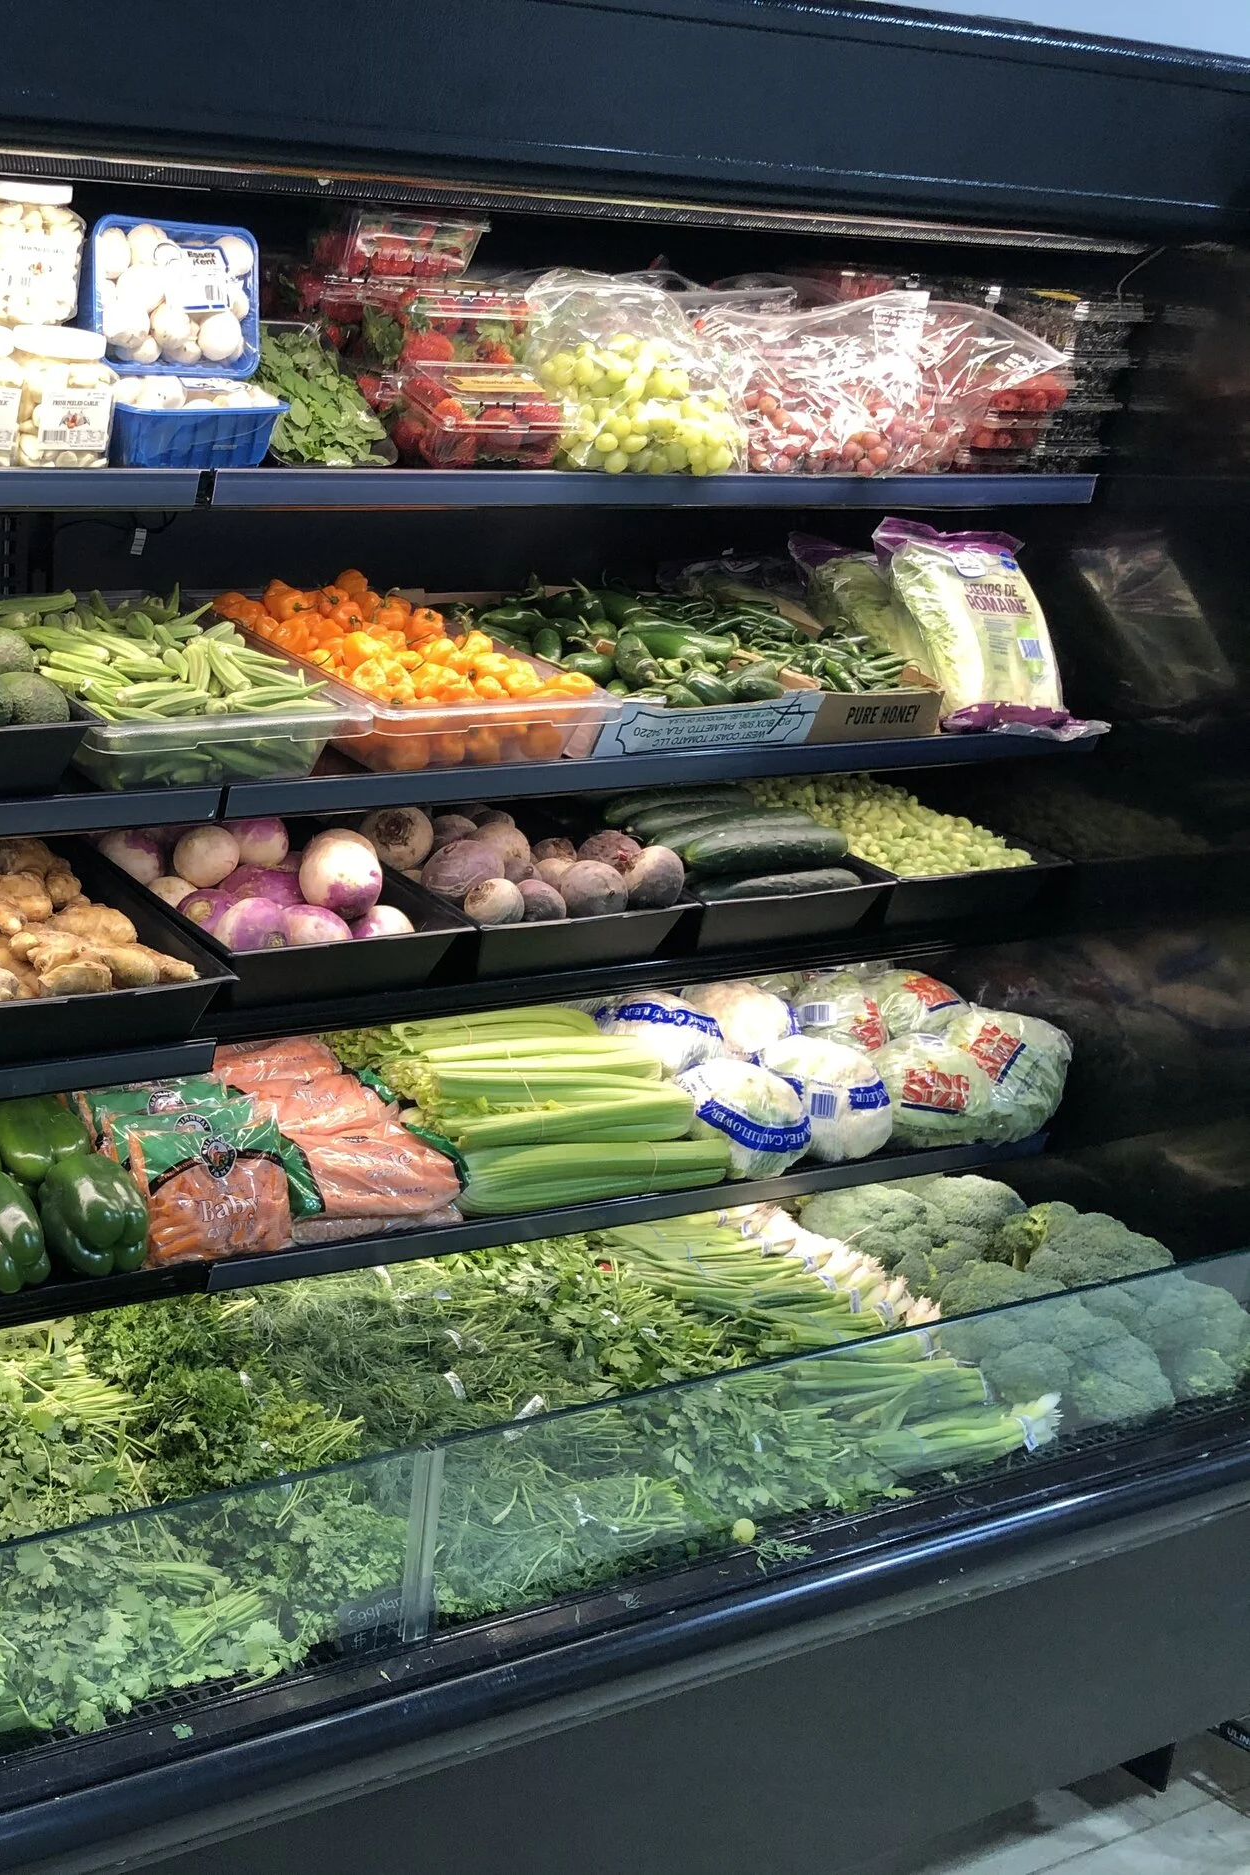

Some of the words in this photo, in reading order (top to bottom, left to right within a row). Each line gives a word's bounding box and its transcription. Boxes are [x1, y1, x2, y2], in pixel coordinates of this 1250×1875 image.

[187, 250, 216, 258] Essex
[193, 258, 216, 266] Kent
[1004, 584, 1018, 597] DE
[965, 594, 1029, 614] ROMAINE
[845, 706, 879, 725] PURE
[879, 704, 921, 724] HONEY
[754, 718, 775, 729] BOX
[671, 734, 709, 745] TOMATO
[710, 732, 740, 742] COAST
[740, 730, 766, 740] WEST
[652, 738, 671, 747] LLC
[905, 1068, 970, 1091] KING
[902, 1083, 969, 1111] SIZE
[711, 1106, 783, 1147] CAULIFLOWER
[200, 1195, 260, 1223] Baby
